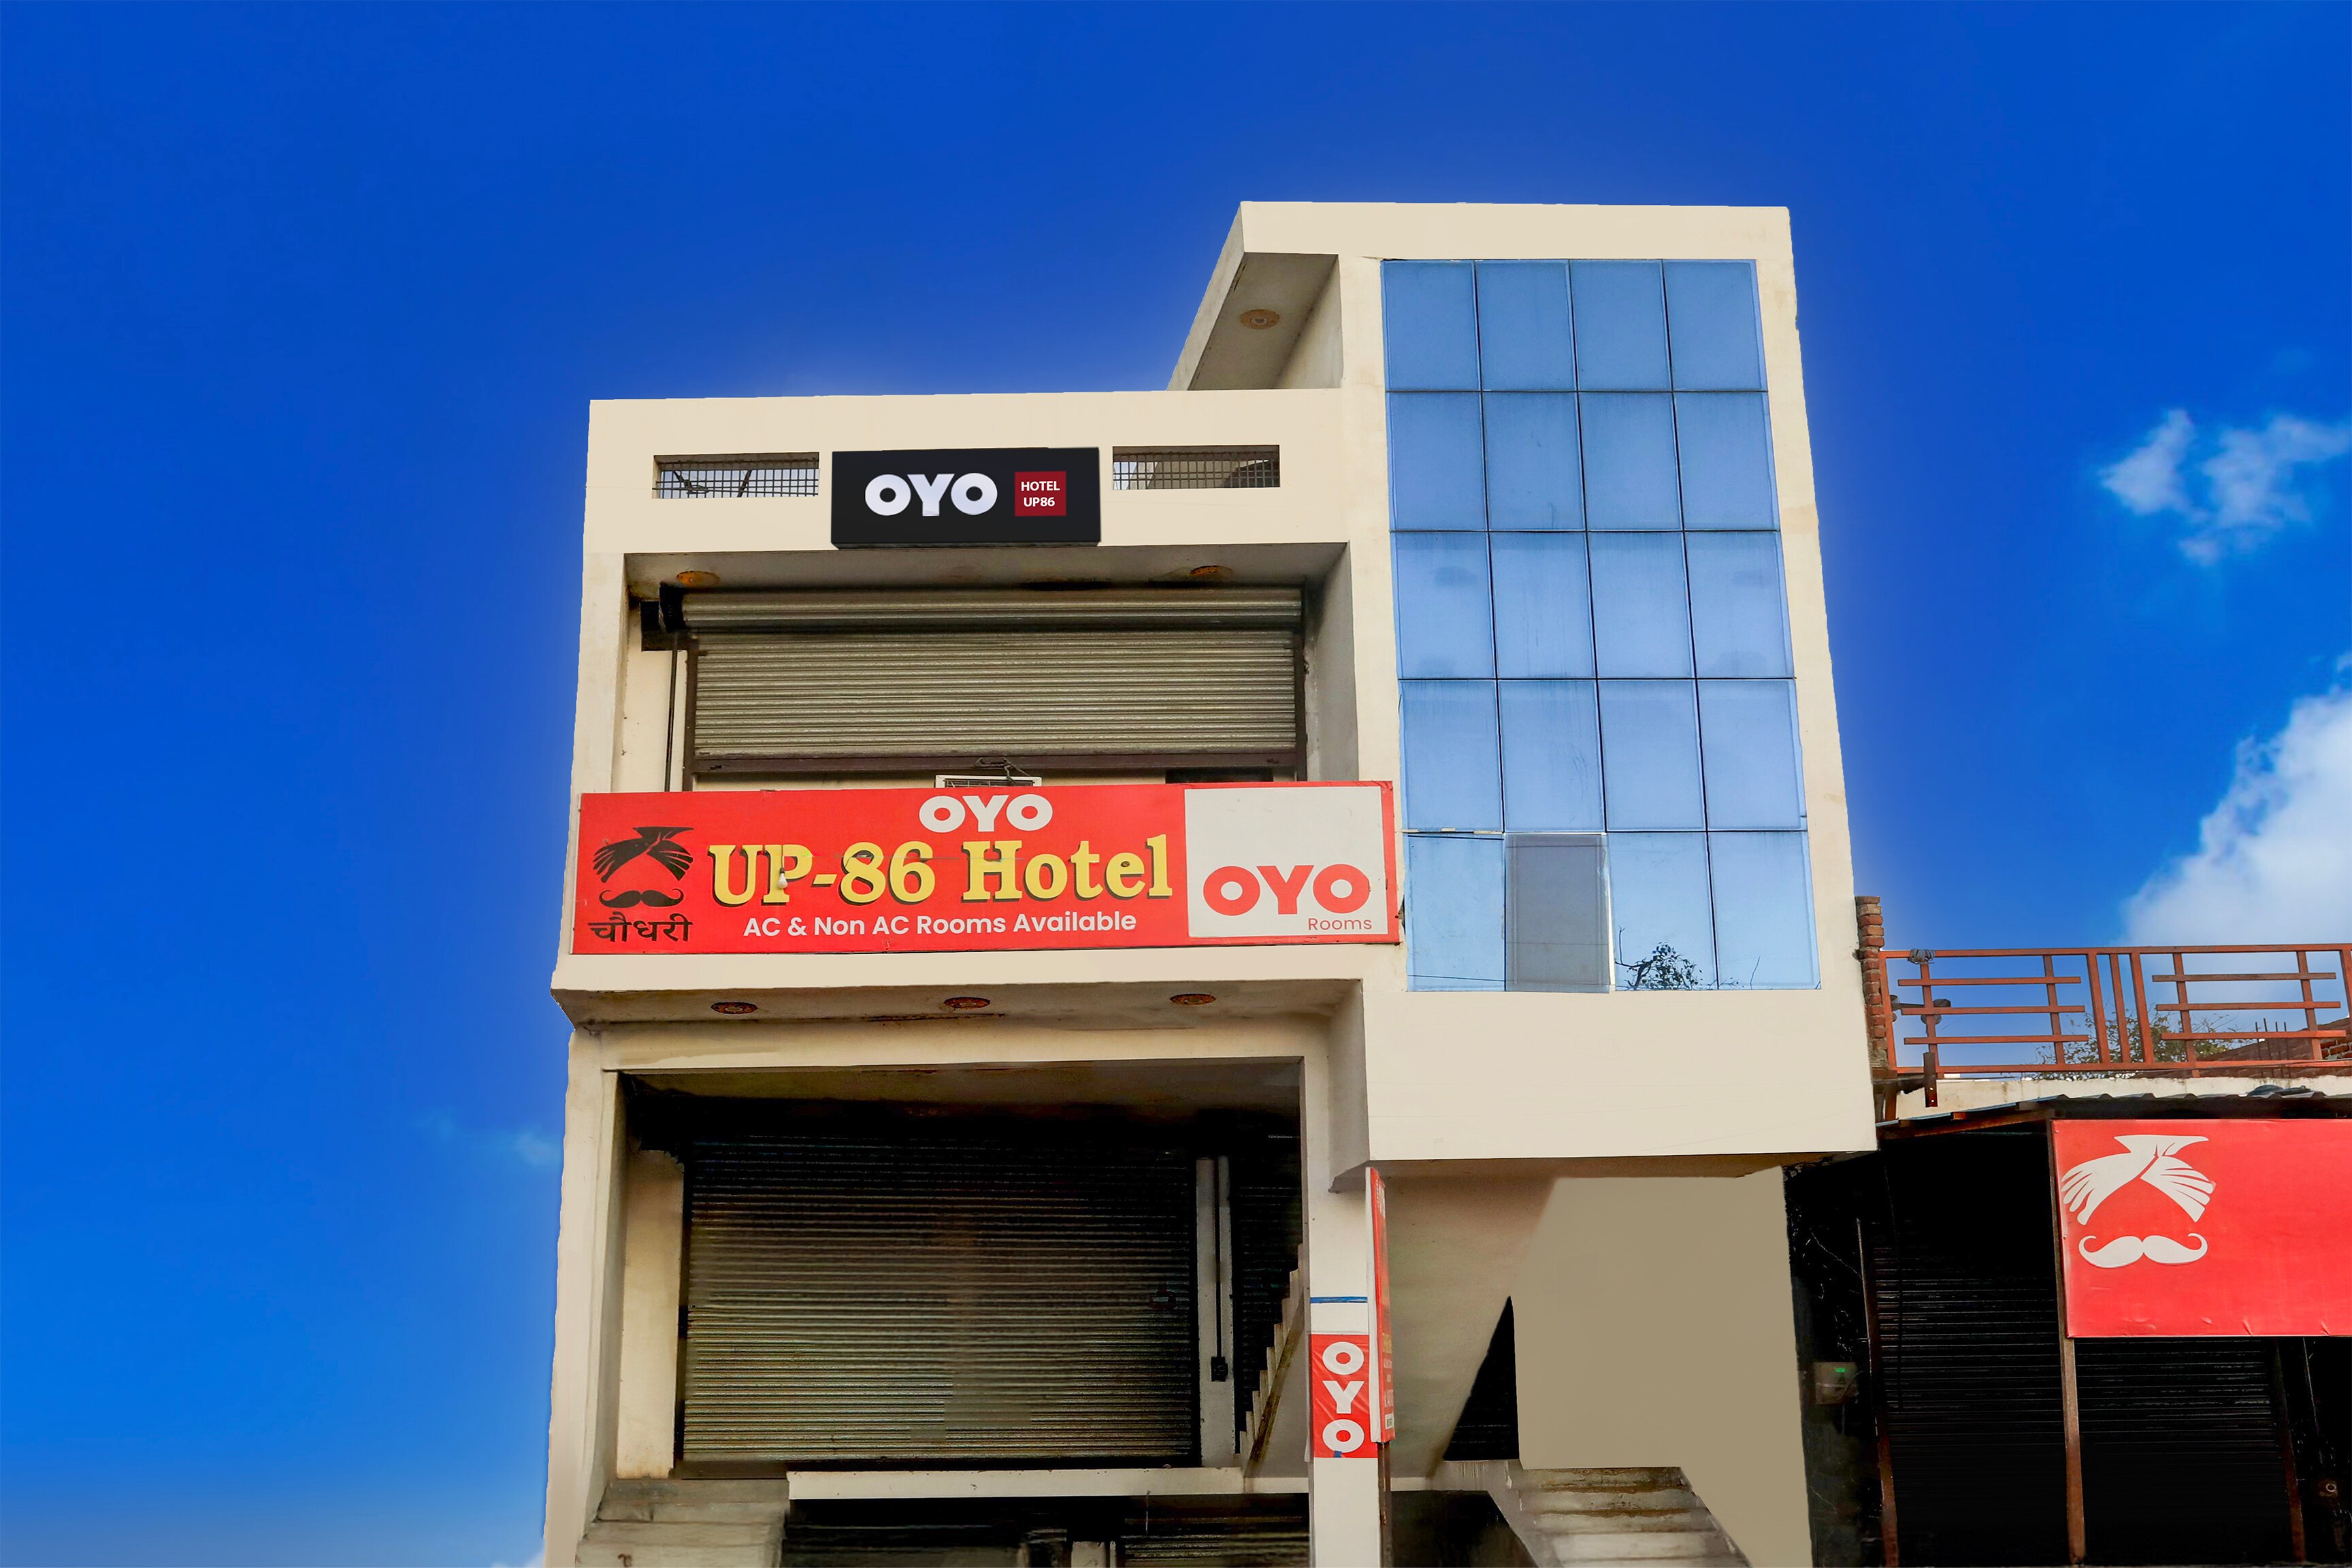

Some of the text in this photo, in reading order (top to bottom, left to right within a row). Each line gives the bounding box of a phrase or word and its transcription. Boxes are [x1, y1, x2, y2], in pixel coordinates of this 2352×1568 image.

[865, 472, 998, 517] OYO
[1021, 480, 1060, 491] HOTEL
[1024, 496, 1056, 507] UP86
[919, 794, 1053, 833] OYO
[708, 834, 1173, 906] UP-86 Hotel
[1203, 864, 1371, 917] OYO
[588, 911, 693, 942] चौधरी
[743, 911, 1137, 936] AC & Non AC Rooms Available
[1307, 917, 1373, 931] Rooms
[1322, 1341, 1365, 1454] OYO
